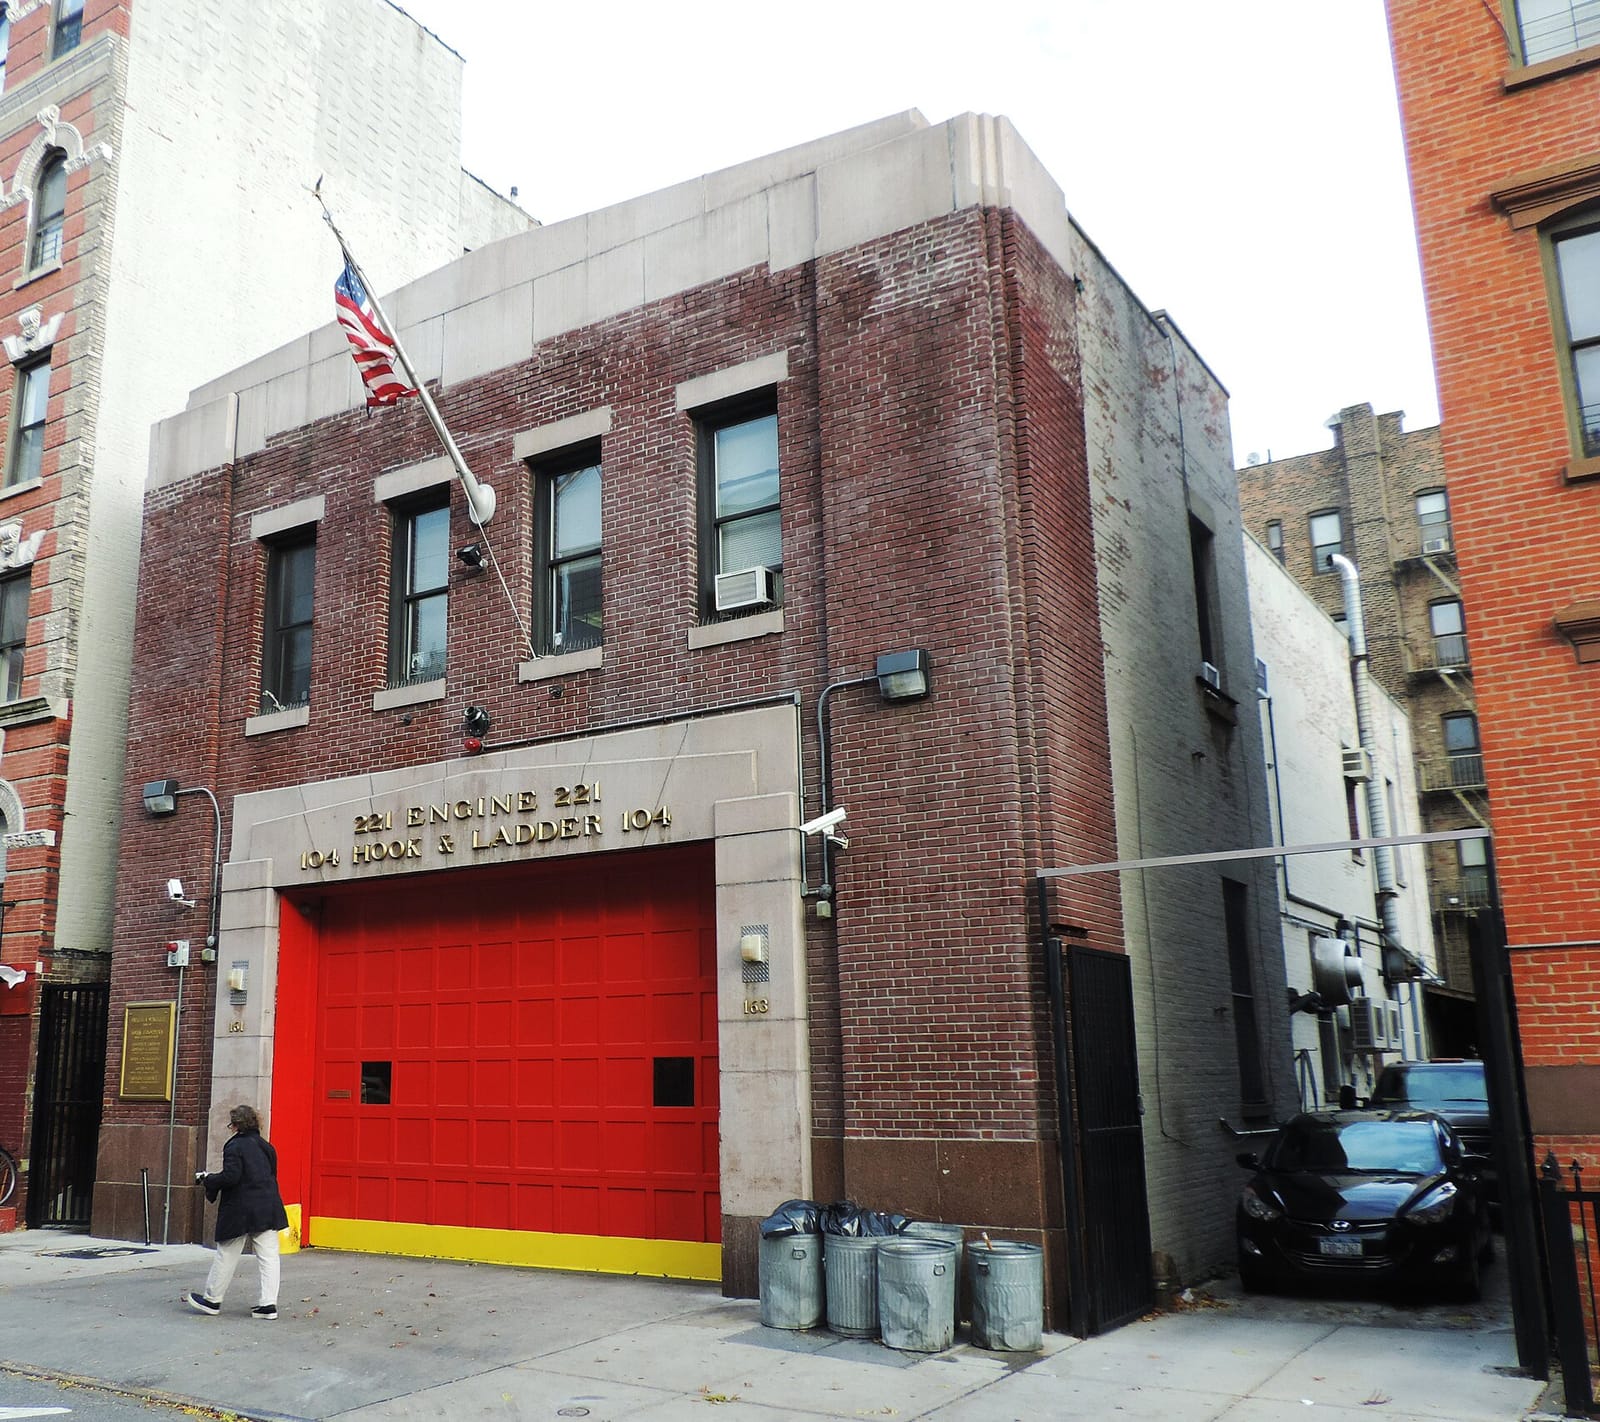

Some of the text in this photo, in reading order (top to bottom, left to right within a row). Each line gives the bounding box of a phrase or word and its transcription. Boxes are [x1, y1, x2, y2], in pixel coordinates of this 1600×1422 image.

[354, 780, 601, 834] 221 ENGINE 221
[301, 805, 672, 870] 104 HOOK & LADDER 104
[743, 998, 769, 1015] 163
